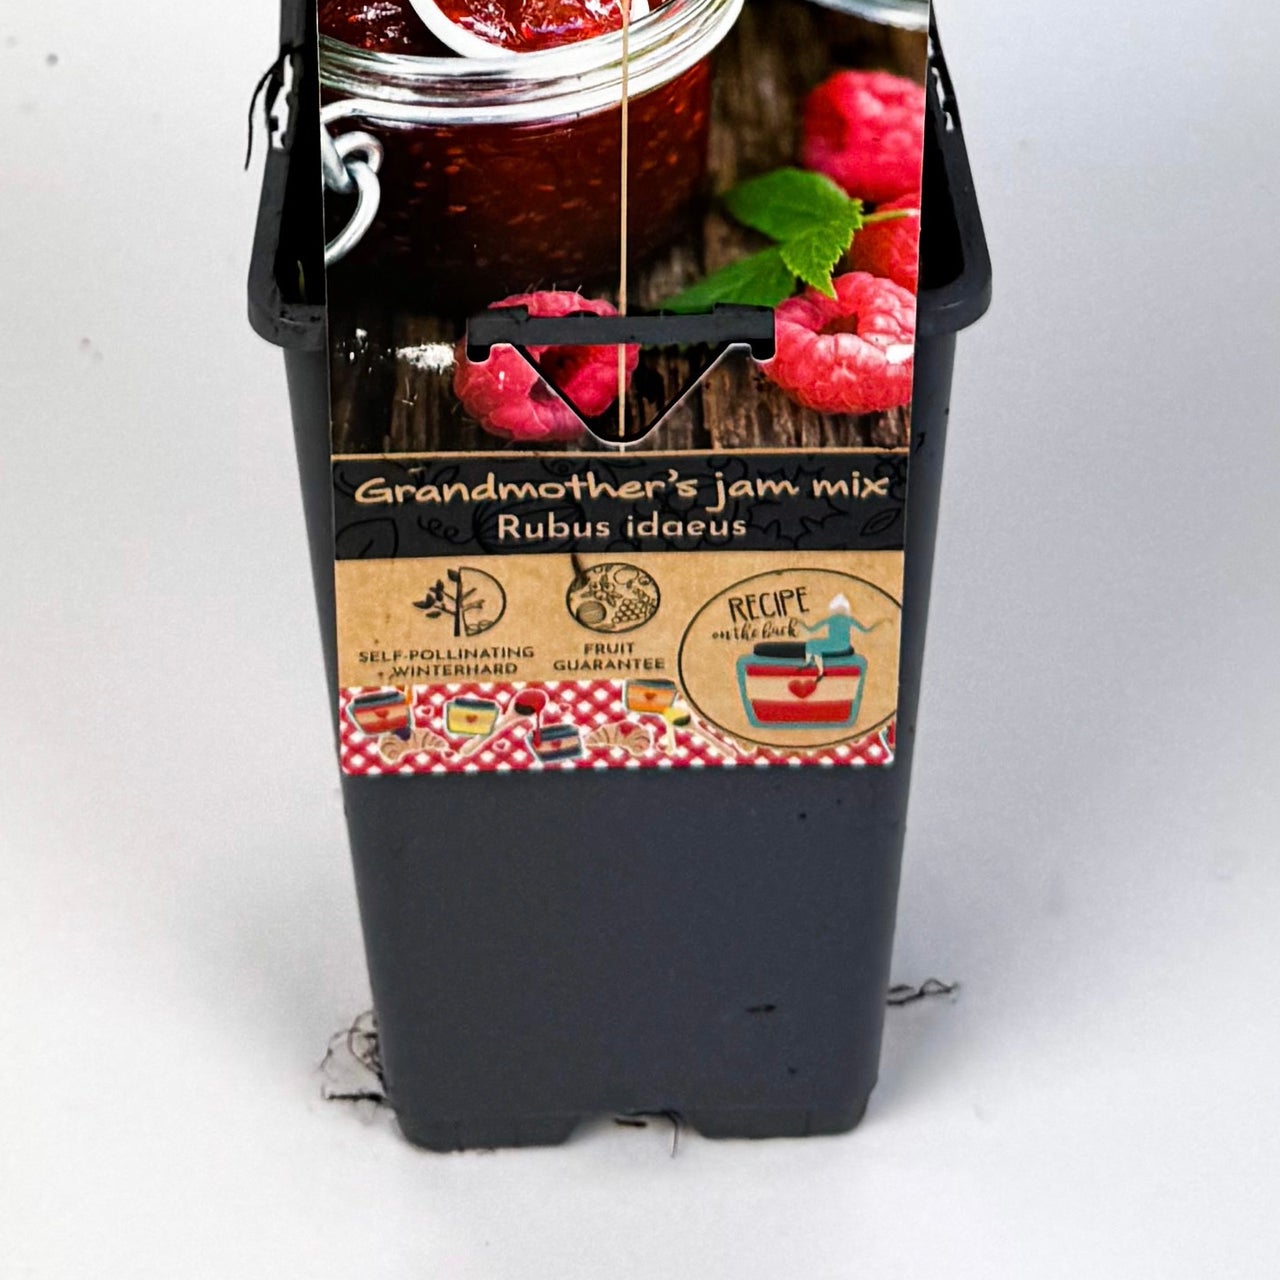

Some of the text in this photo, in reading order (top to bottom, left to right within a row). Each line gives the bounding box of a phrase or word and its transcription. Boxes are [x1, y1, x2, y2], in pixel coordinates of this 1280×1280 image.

[354, 469, 889, 512] Grandmother's jam mix
[498, 511, 747, 540] Rubus idaeus
[728, 587, 810, 622] RECIPE
[359, 646, 535, 663] SELF-POLLINATING
[584, 642, 634, 655] FRUIT
[553, 658, 665, 671] GUARANTEE
